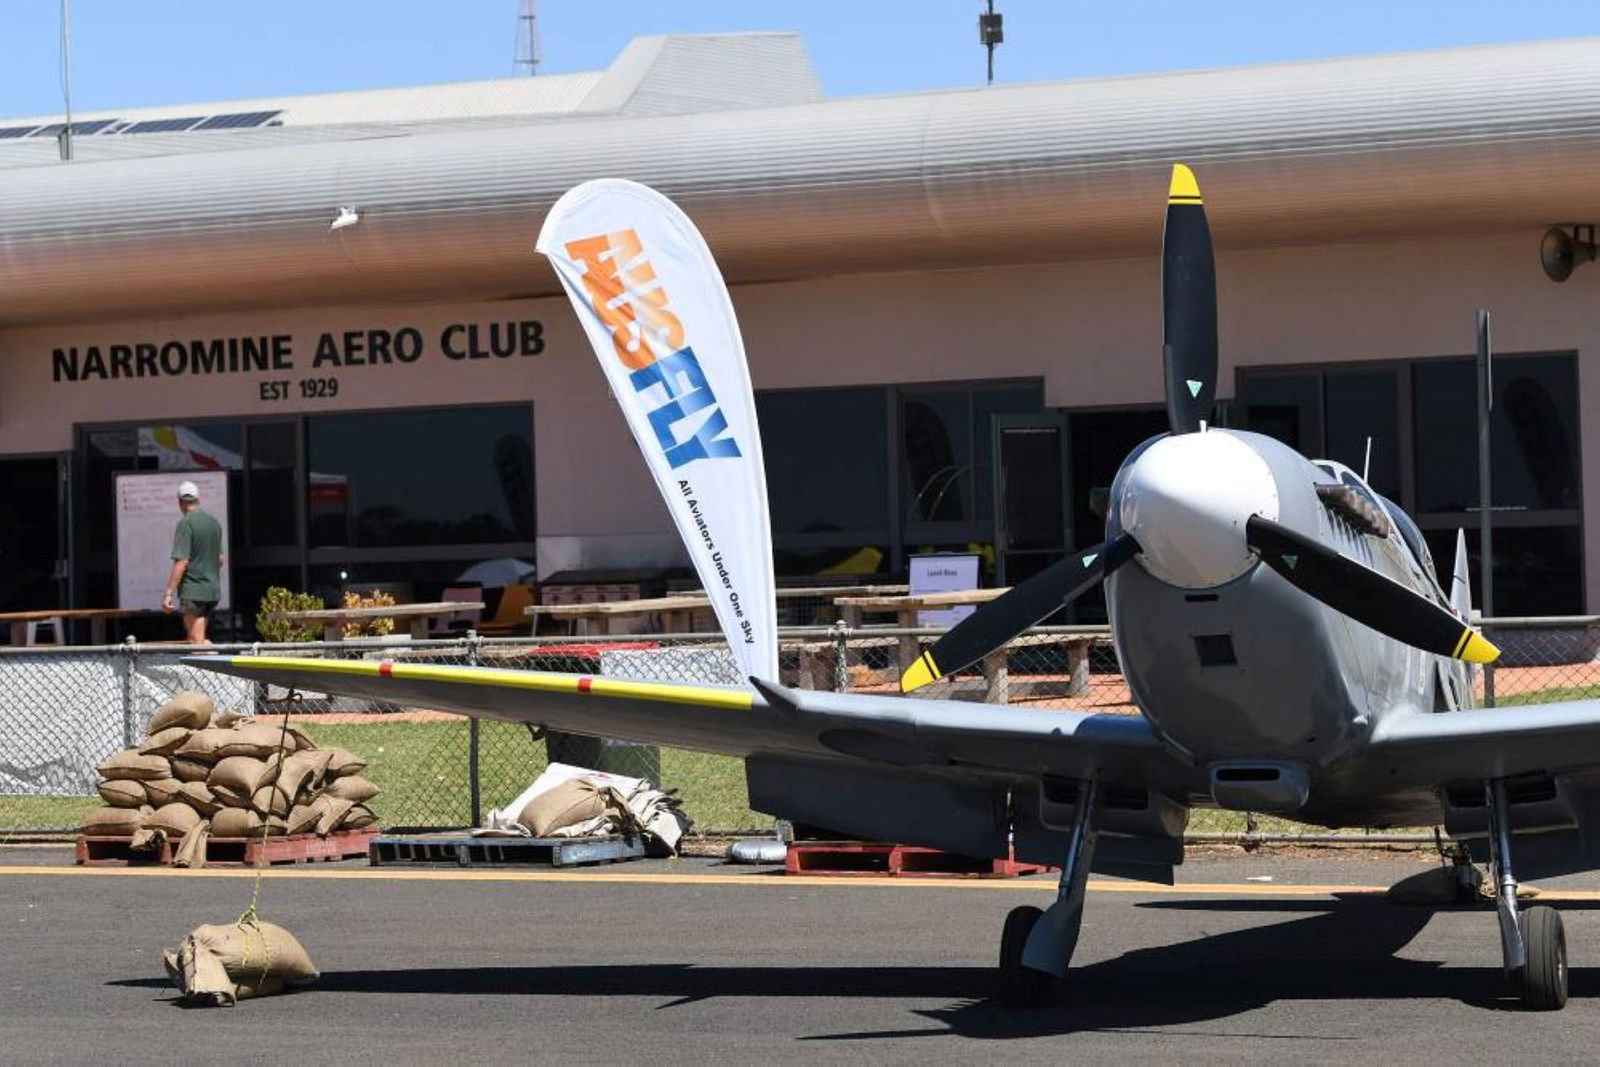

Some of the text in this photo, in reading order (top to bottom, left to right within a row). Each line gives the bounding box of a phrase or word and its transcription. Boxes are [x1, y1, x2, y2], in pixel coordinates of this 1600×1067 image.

[53, 320, 546, 382] NARROMINE AERO CLUB
[259, 377, 339, 400] EST 1929
[565, 228, 742, 470] AUSFLY
[678, 479, 755, 645] All Aviators Under One Sky
